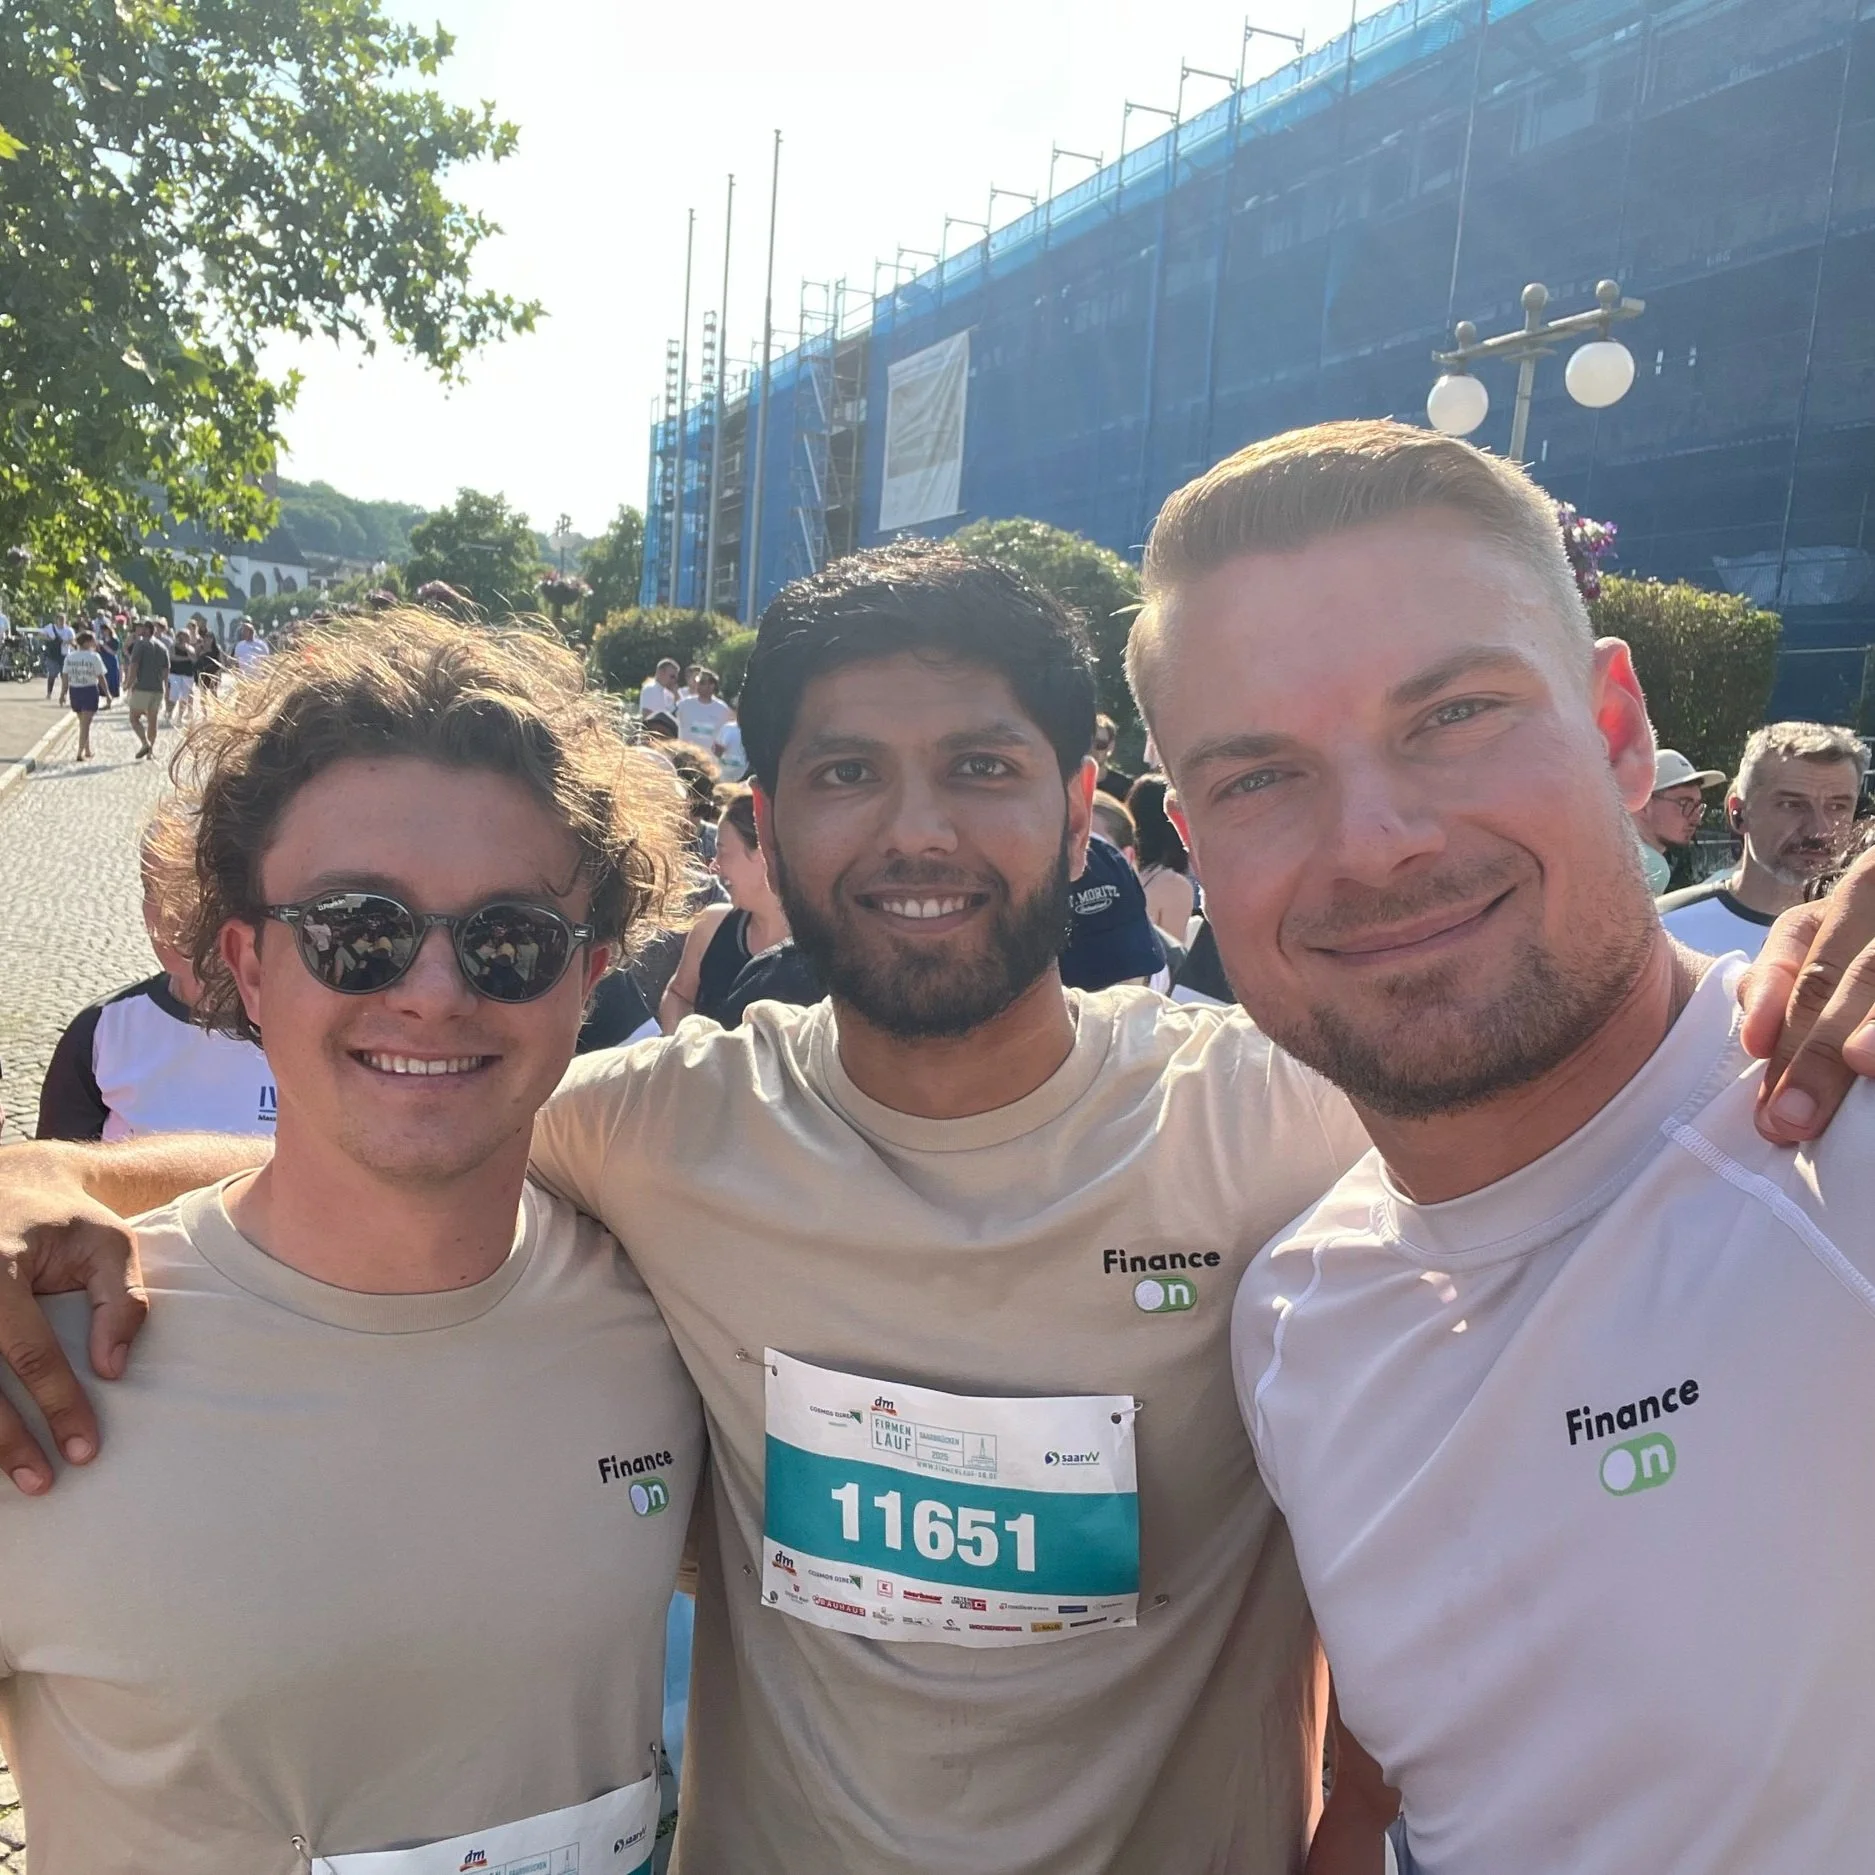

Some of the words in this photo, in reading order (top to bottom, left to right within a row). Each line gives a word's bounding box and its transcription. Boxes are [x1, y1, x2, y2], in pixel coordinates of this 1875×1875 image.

[1077, 885, 1120, 903] MORITZ
[1103, 1249, 1221, 1274] Finance
[874, 1396, 894, 1410] dm
[1566, 1379, 1699, 1446] Finance
[874, 1418, 912, 1437] FIRMEN
[874, 1430, 912, 1452] LAUF
[598, 1450, 675, 1484] Finance
[831, 1482, 1036, 1573] 11651
[775, 1551, 794, 1569] dm
[819, 1599, 865, 1616] BAUHAUS
[464, 1850, 485, 1864] dm
